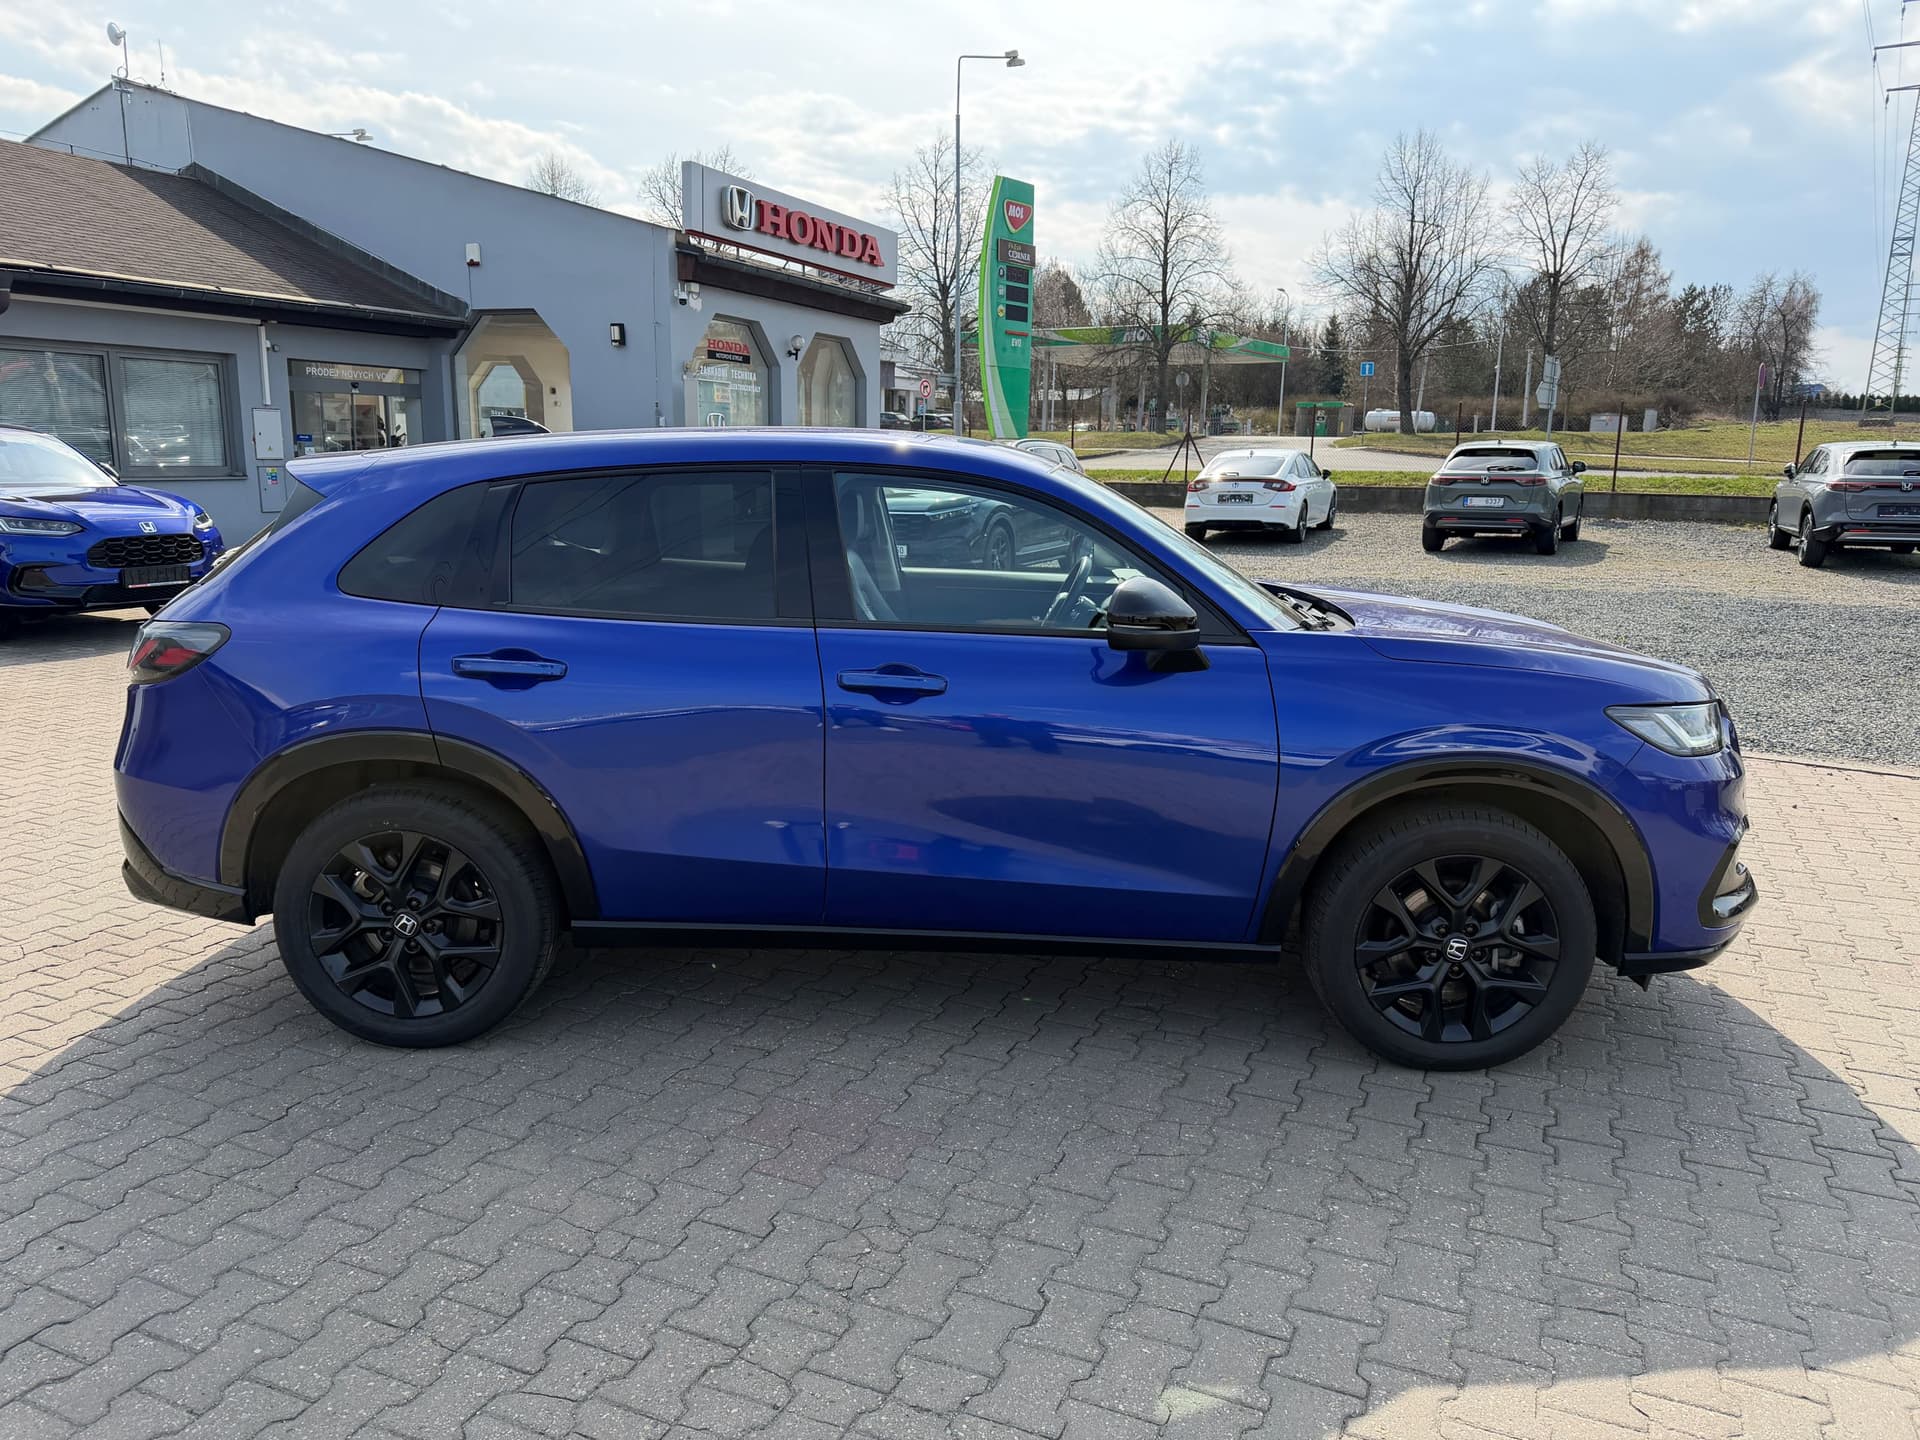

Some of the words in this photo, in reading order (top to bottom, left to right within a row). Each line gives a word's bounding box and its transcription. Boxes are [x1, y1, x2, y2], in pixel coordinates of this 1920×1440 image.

[1009, 205, 1024, 219] MOL
[758, 199, 884, 267] HONDA
[707, 339, 749, 354] HONDA
[305, 366, 339, 377] PRODEJ
